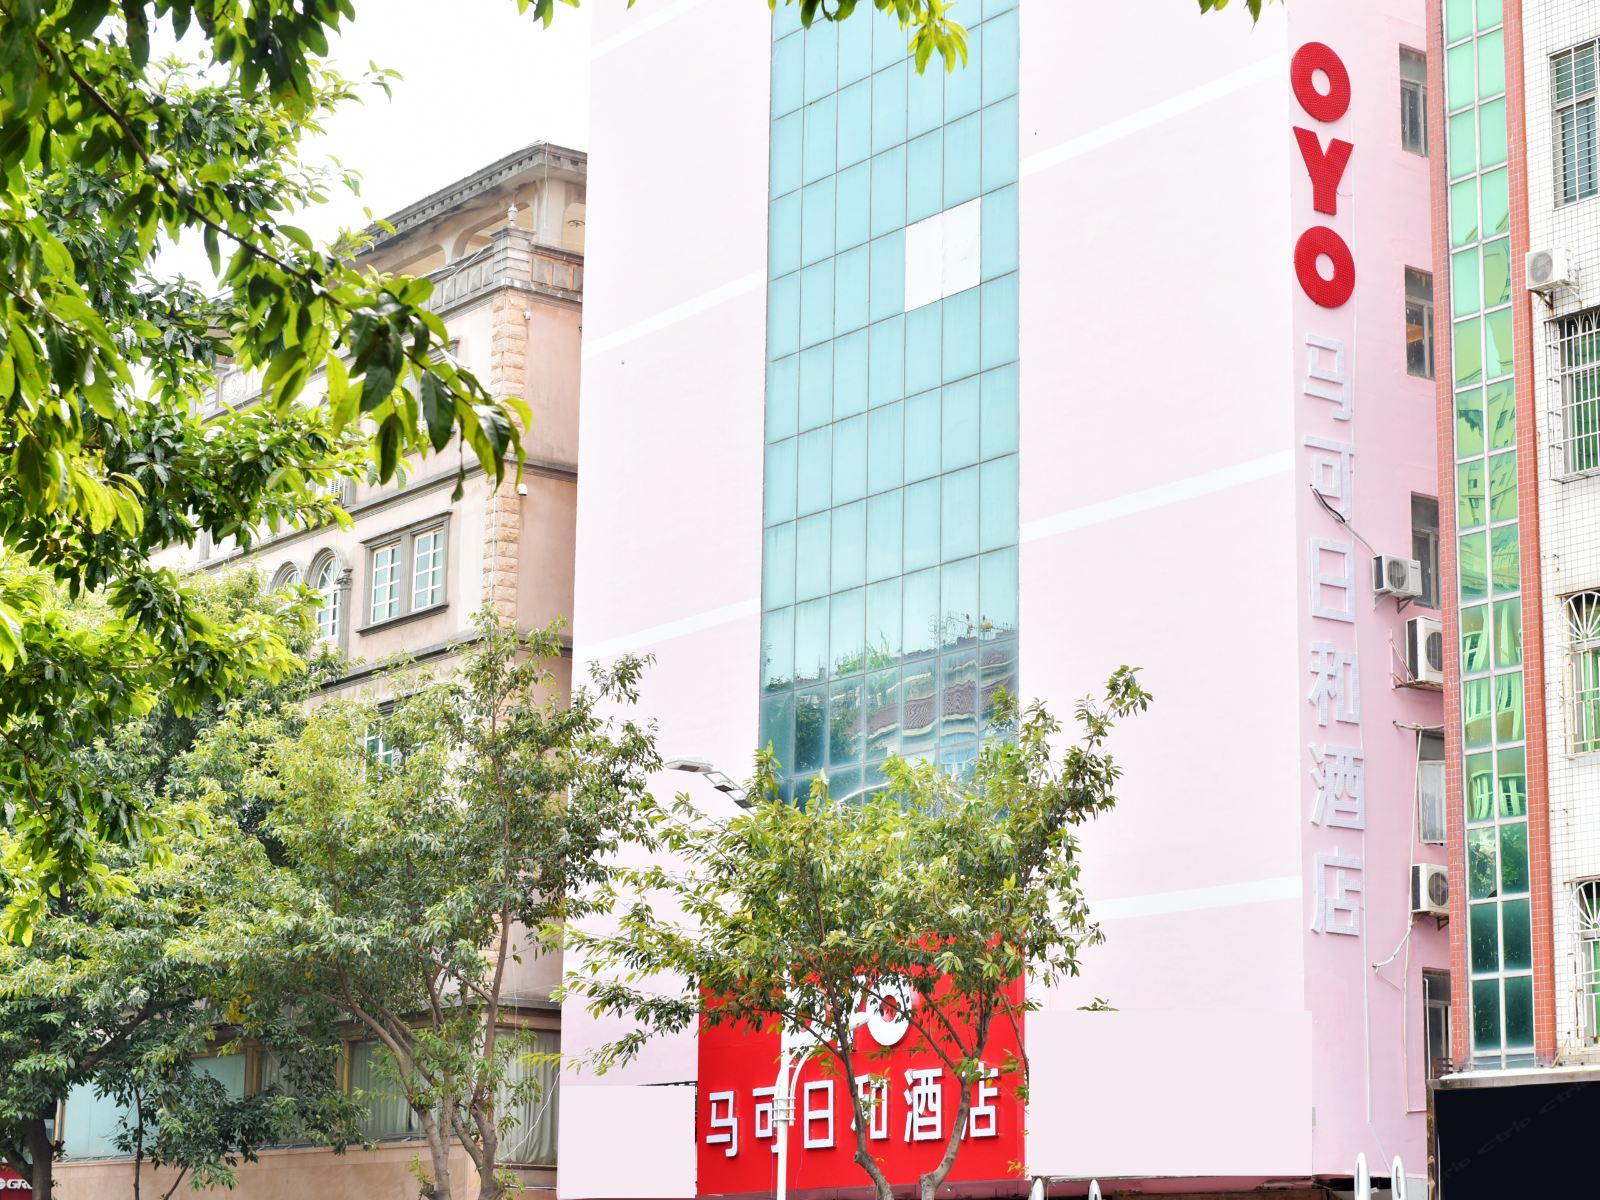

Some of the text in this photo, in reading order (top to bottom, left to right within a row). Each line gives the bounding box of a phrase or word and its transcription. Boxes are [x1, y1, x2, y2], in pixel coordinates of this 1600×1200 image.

[1291, 42, 1355, 308] OYO
[1303, 333, 1364, 936] 马可日和酒店
